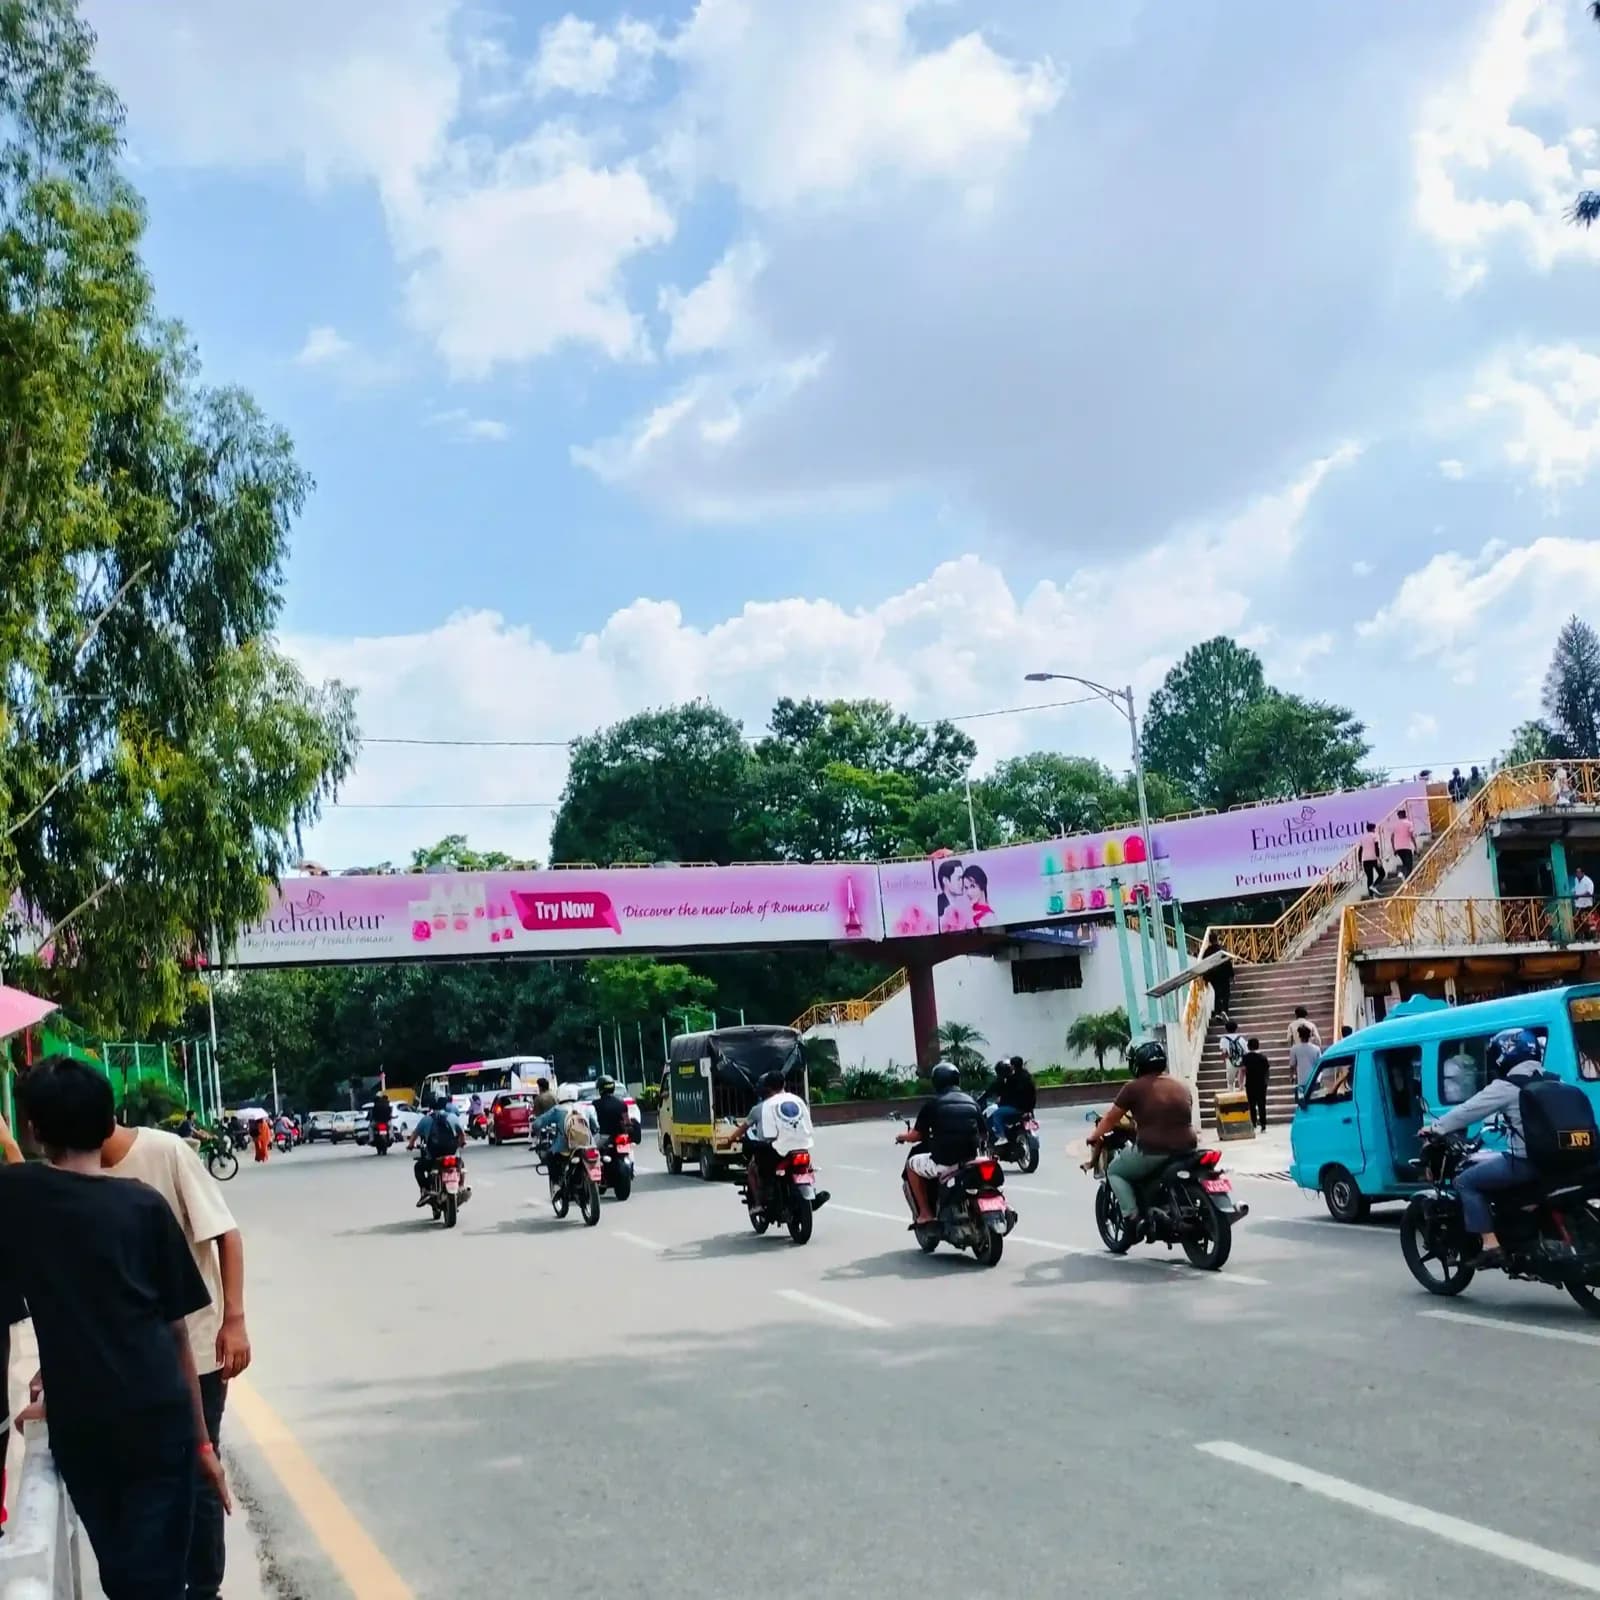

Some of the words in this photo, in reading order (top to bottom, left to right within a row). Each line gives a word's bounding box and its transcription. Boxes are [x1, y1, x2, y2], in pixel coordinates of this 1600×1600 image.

[1235, 866, 1302, 887] Perfumed
[534, 901, 559, 921] Try
[561, 900, 595, 919] Now
[623, 904, 675, 918] Discover
[678, 902, 699, 916] the
[702, 904, 728, 916] new
[730, 901, 755, 915] look
[757, 900, 770, 922] of
[771, 900, 830, 914] Romance!
